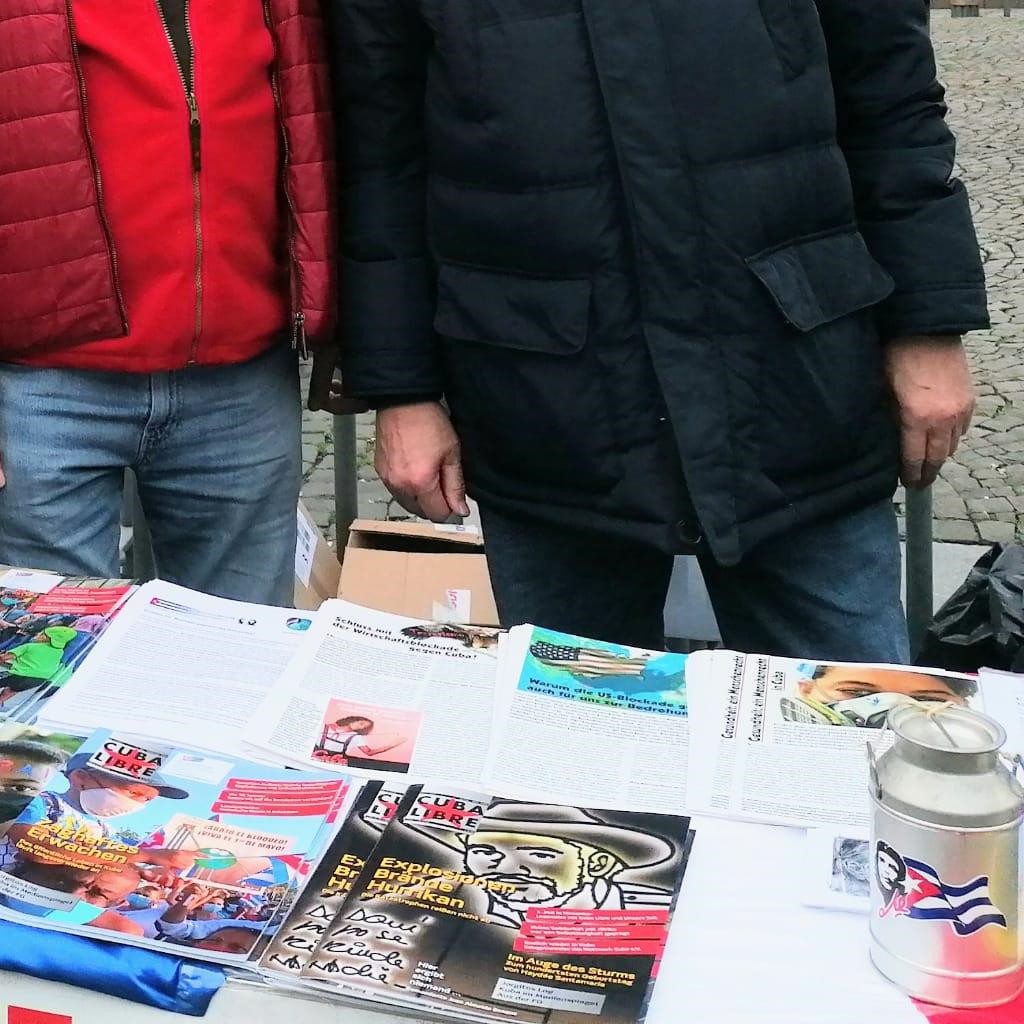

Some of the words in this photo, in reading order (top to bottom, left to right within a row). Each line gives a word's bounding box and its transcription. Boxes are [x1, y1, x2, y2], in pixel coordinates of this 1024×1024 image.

[336, 616, 372, 631] Schluss
[332, 622, 351, 631] der
[353, 628, 460, 652] Wirtschaftsblockade
[409, 646, 442, 656] gegen
[527, 685, 556, 697] auch
[559, 690, 577, 700] für
[579, 695, 601, 704] uns
[603, 699, 624, 708] zur
[529, 677, 570, 692] Warum
[573, 687, 594, 696] die
[597, 691, 675, 709] US-Blockade
[93, 752, 154, 777] LIBRE
[103, 742, 163, 766] CUBA
[417, 795, 484, 817] CUBA
[410, 807, 478, 828] LIBRE
[26, 826, 128, 865] Erwachen
[38, 819, 140, 855] Zaghaftes
[340, 854, 366, 868] Ex
[334, 866, 360, 879] Br
[373, 868, 455, 893] Brände
[379, 856, 517, 894] Explosionen
[366, 879, 465, 909] Hurrikan
[457, 911, 479, 921] nicht
[414, 968, 445, 980] ergibt
[417, 961, 439, 971] Hier
[503, 966, 520, 974] von
[505, 959, 525, 969] Zum
[525, 963, 581, 977] hundertsten
[581, 972, 634, 987] Geburtstag
[507, 953, 524, 963] Im
[525, 957, 560, 970] Auge
[561, 963, 587, 973] des
[587, 967, 636, 980] Sturms
[409, 979, 452, 994] niemand
[411, 973, 432, 983] sich
